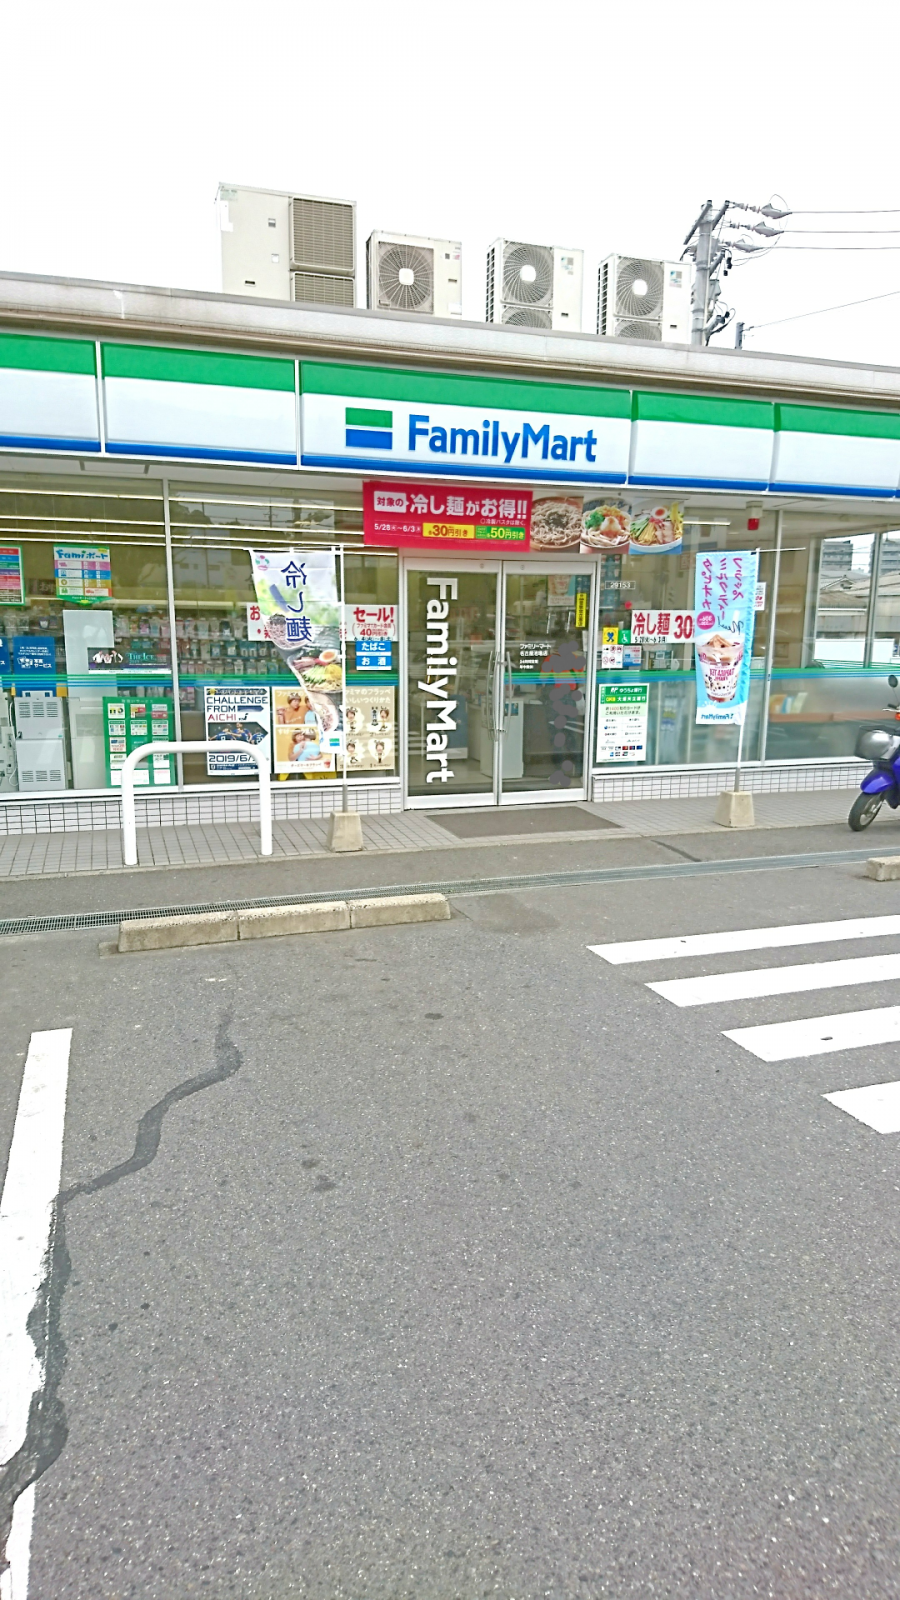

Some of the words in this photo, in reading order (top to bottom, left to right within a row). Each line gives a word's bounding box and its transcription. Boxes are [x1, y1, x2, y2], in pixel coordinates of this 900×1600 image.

[408, 413, 598, 463] FamilyMart
[376, 496, 404, 507] 対象の
[56, 549, 108, 559] Famiポート
[250, 605, 260, 621] お
[353, 607, 394, 623] セール!
[633, 612, 671, 636] 冷し麺
[673, 615, 695, 639] 30
[361, 642, 386, 651] たばこ
[361, 656, 387, 666] お酒
[417, 577, 458, 784] FamilyMart
[206, 696, 269, 704] CHALLENGE
[207, 705, 236, 713] FROM
[208, 713, 236, 721] AICHI
[208, 754, 256, 763] 2019/6/
